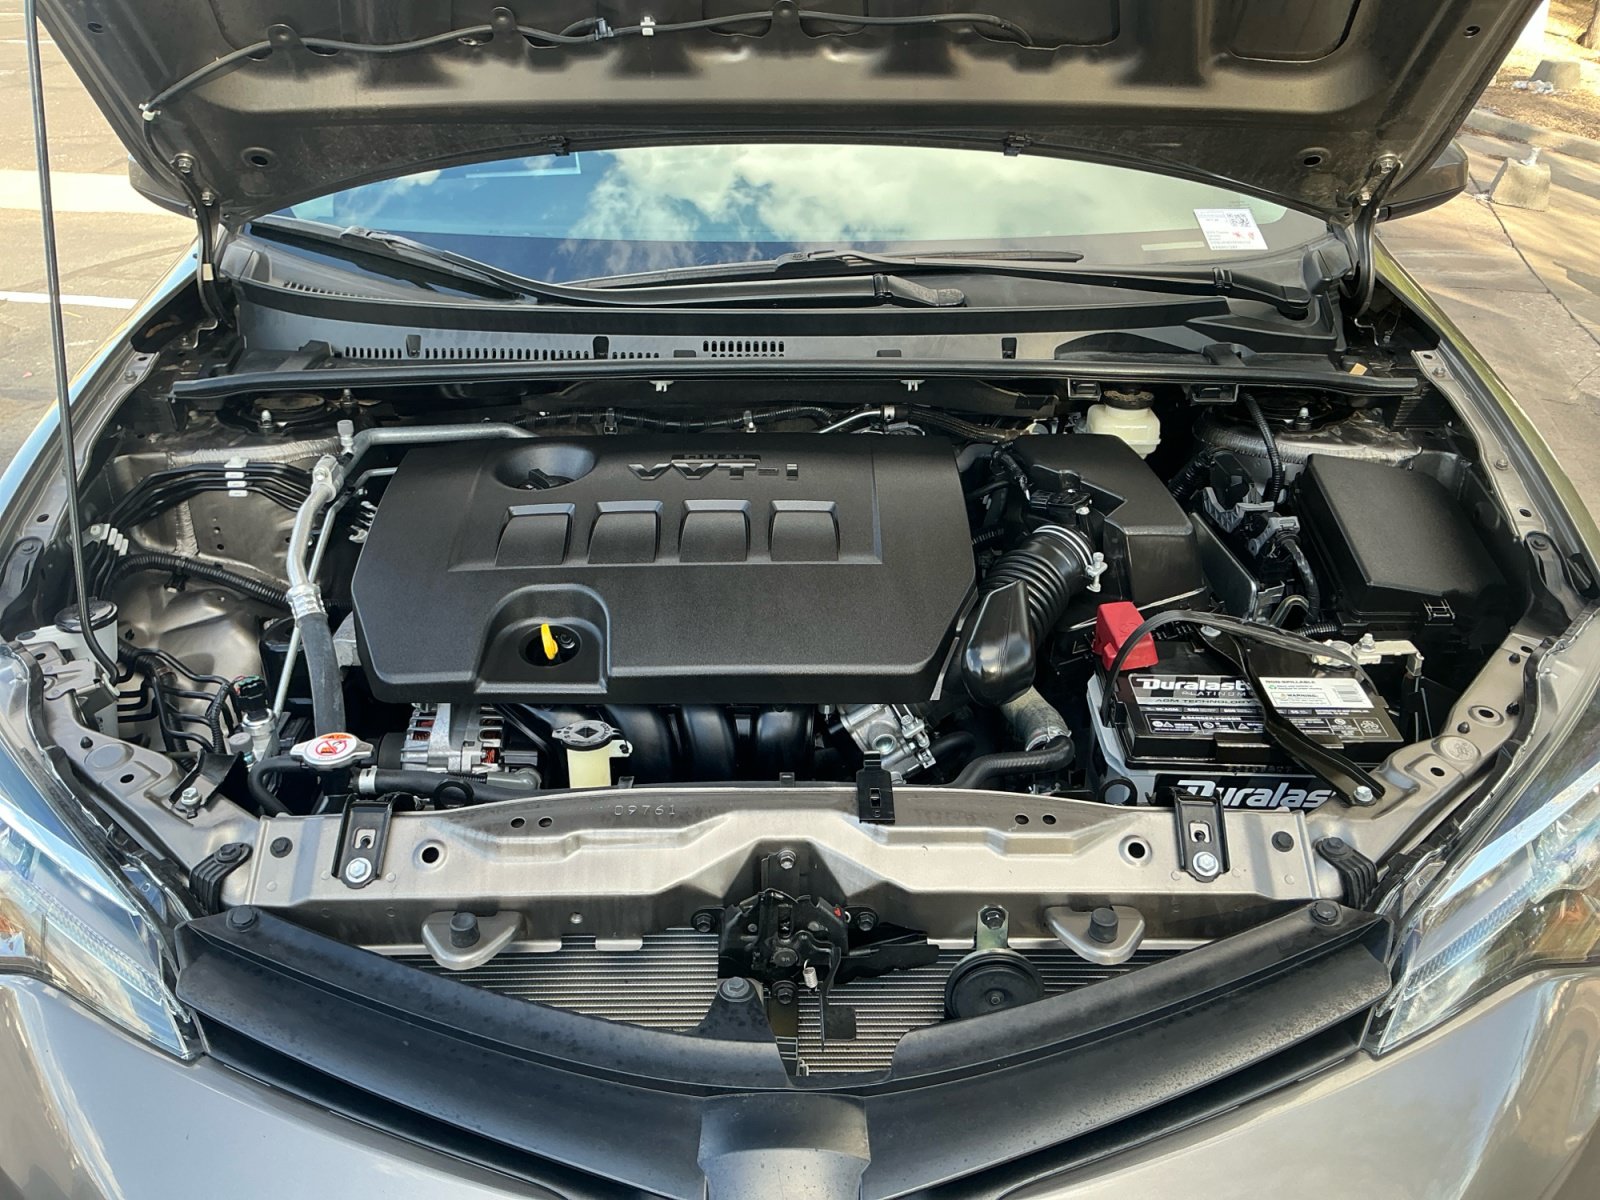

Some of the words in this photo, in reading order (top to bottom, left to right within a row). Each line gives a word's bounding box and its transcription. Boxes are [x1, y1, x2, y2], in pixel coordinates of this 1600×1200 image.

[1136, 679, 1251, 690] Duralast
[1177, 780, 1336, 807] Duralas
[614, 804, 676, 815] 09761
